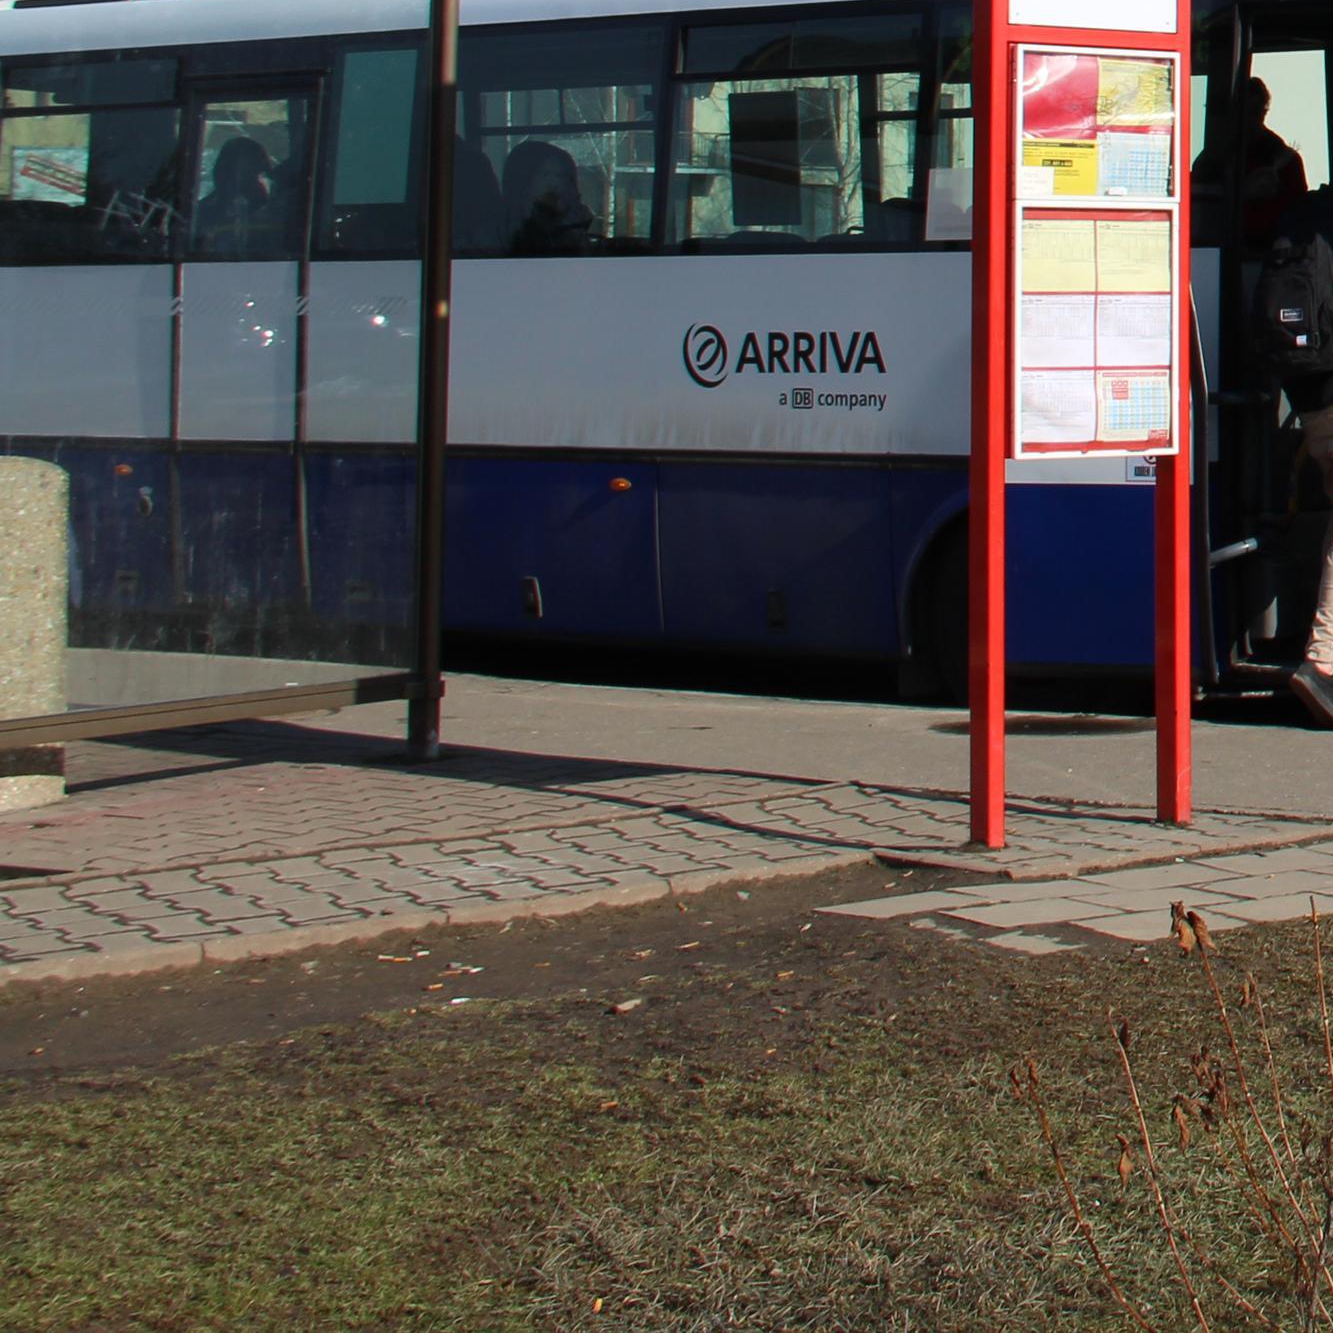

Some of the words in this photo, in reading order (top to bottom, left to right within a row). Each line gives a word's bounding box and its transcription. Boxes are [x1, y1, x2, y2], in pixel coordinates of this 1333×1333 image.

[735, 331, 887, 374] ARRIVA
[779, 393, 787, 406] a
[793, 389, 813, 409] DB
[818, 393, 887, 411] company
